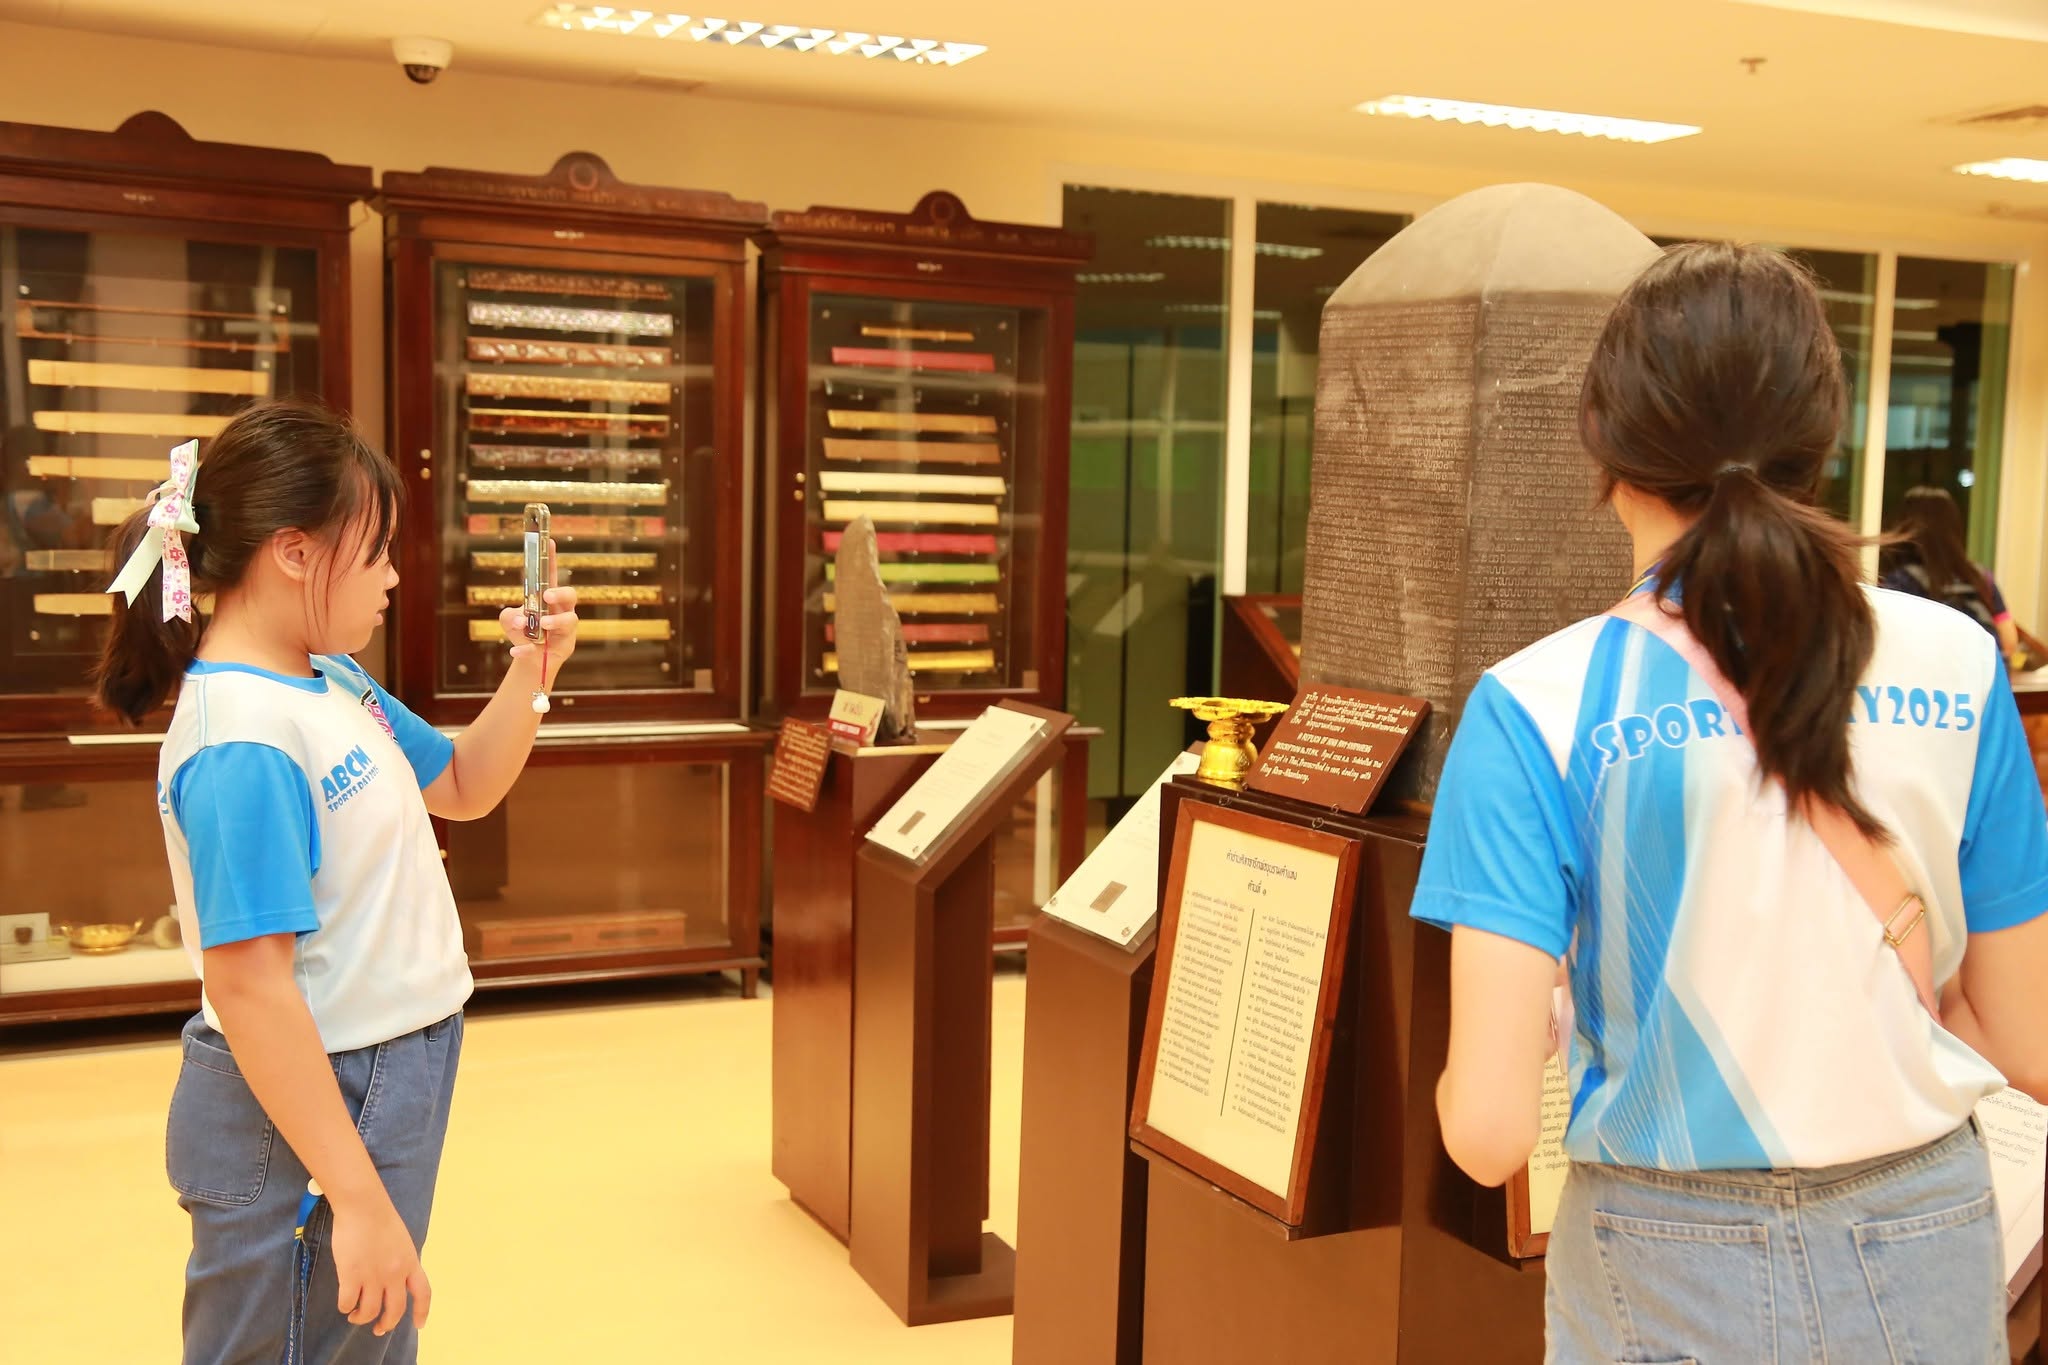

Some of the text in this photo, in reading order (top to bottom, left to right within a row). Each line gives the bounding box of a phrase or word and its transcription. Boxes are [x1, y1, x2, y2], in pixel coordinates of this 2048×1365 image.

[1591, 685, 1975, 767] SPOR Y2025
[327, 784, 360, 812] SPORTS
